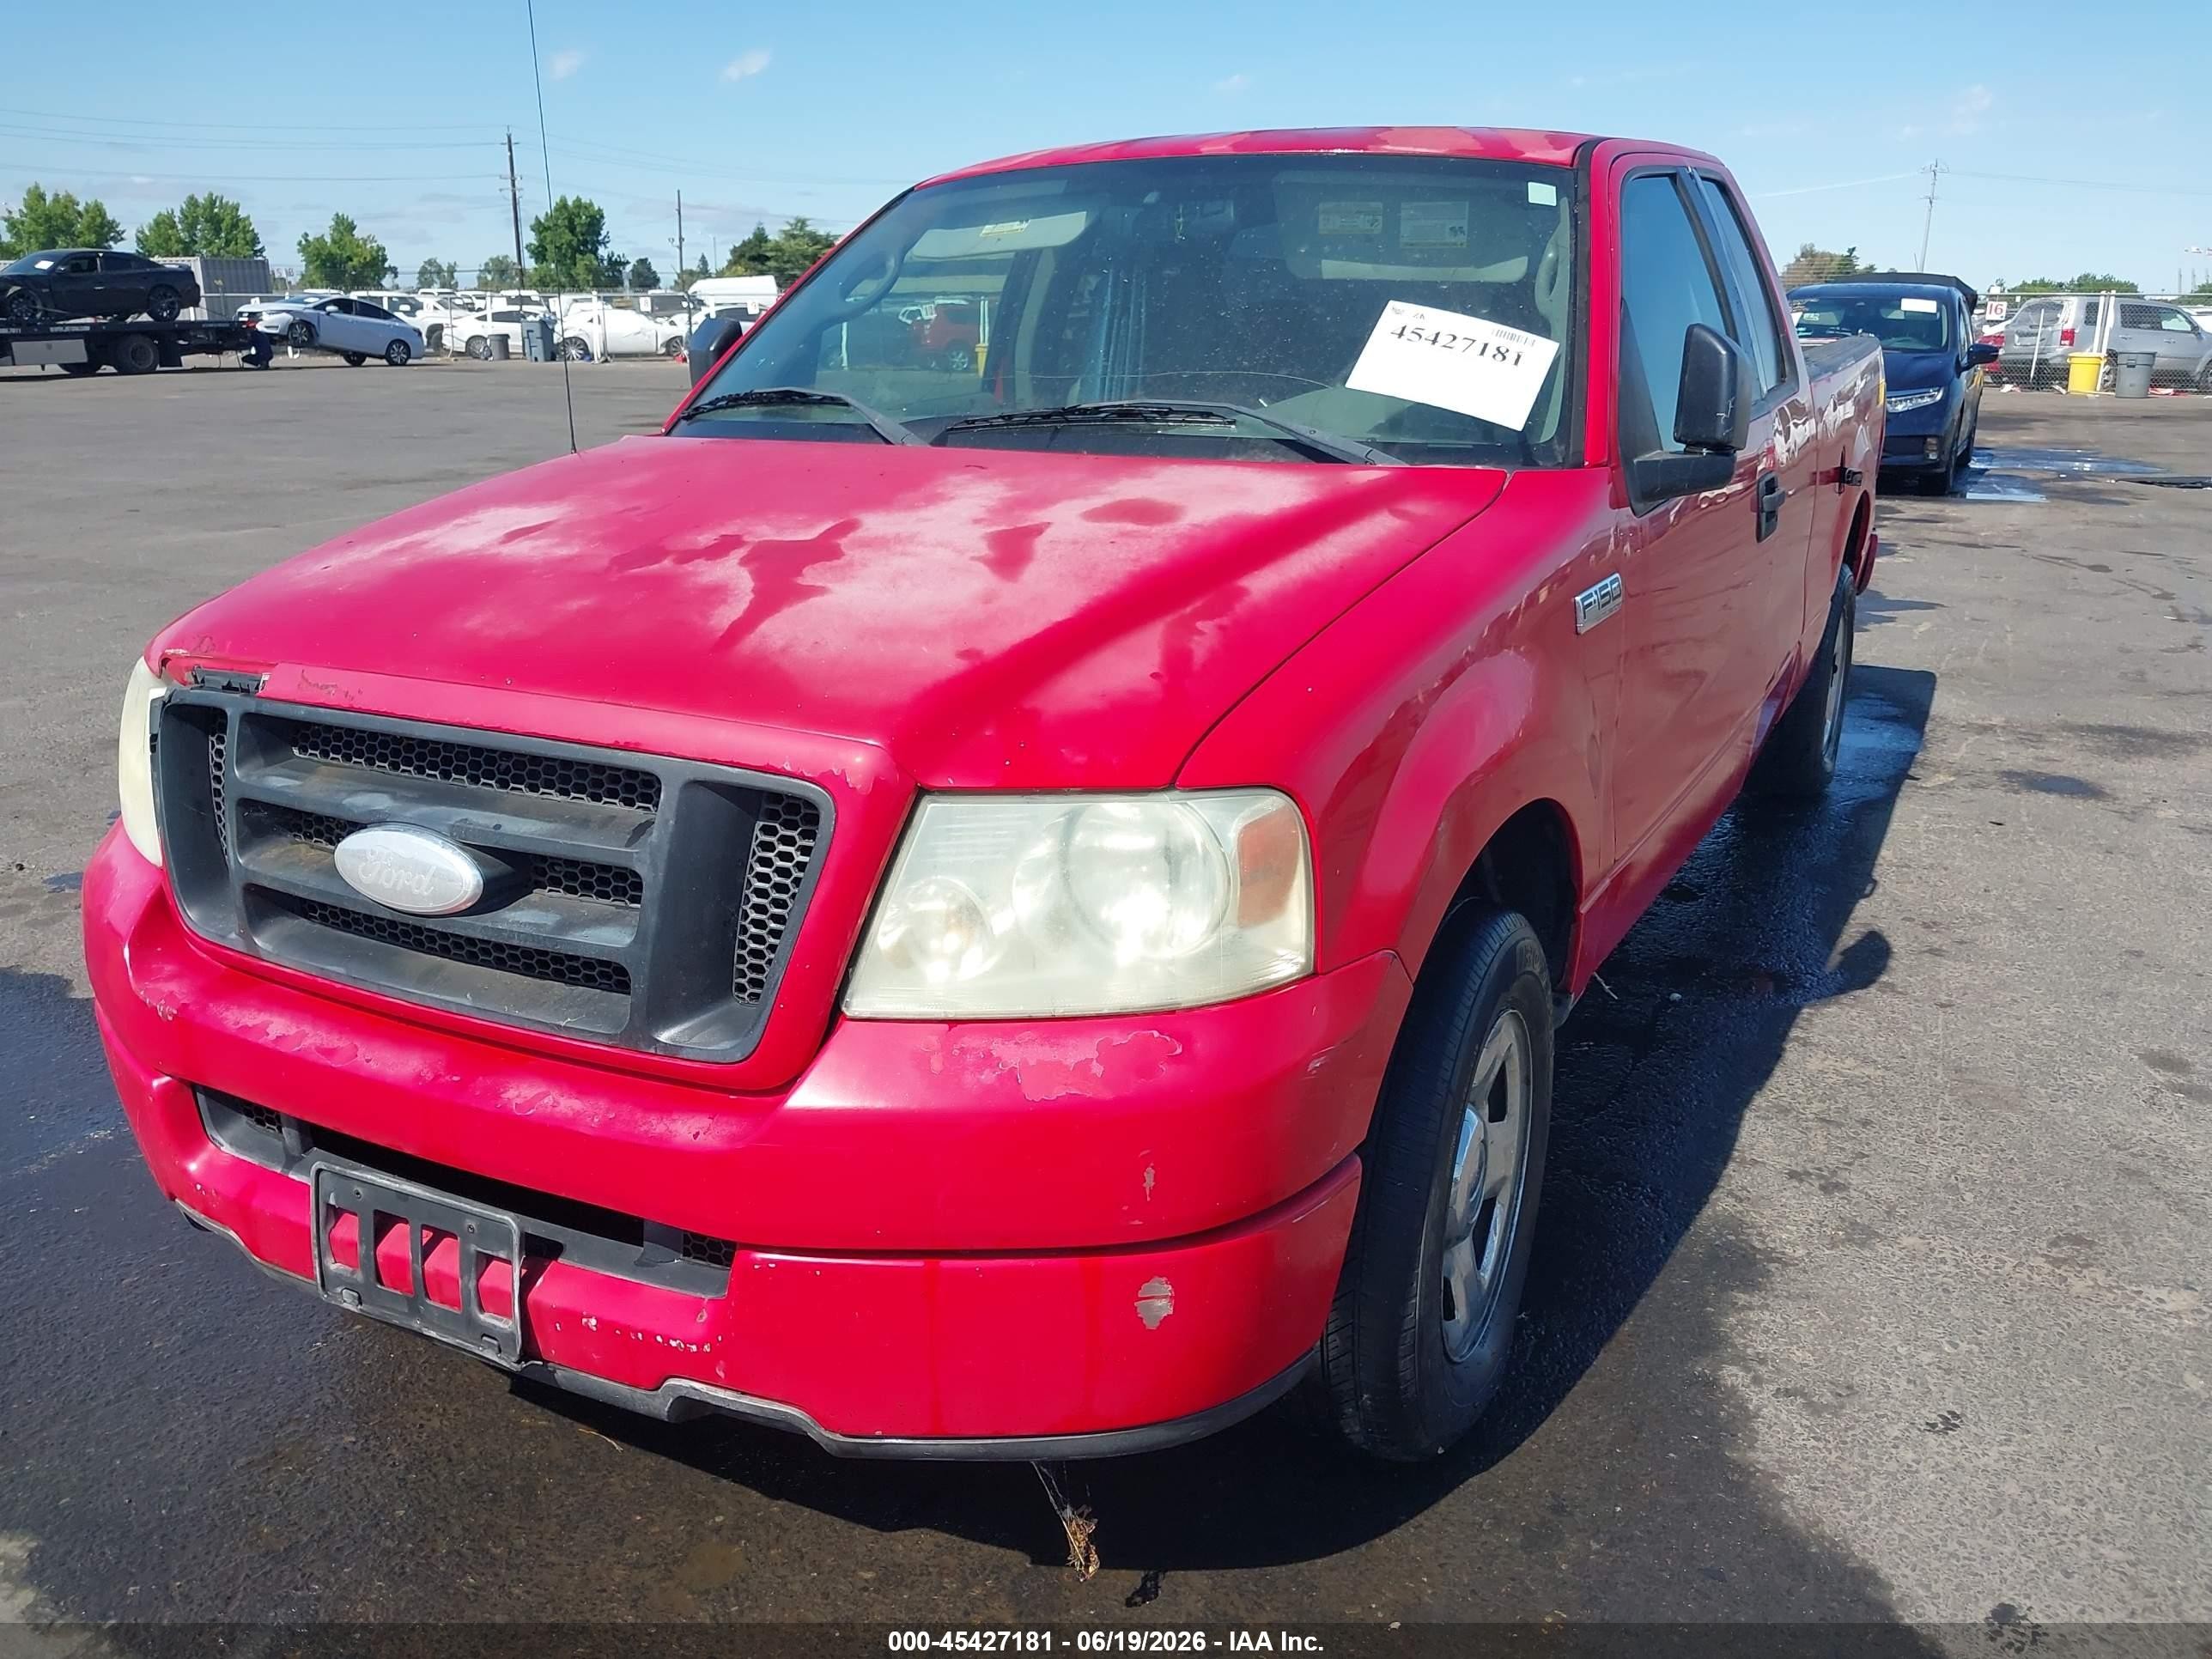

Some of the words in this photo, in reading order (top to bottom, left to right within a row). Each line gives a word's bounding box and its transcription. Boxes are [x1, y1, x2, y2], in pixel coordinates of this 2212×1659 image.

[1989, 303, 2004, 315] 16
[1390, 325, 1522, 367] 45427181
[357, 847, 439, 895] Ford
